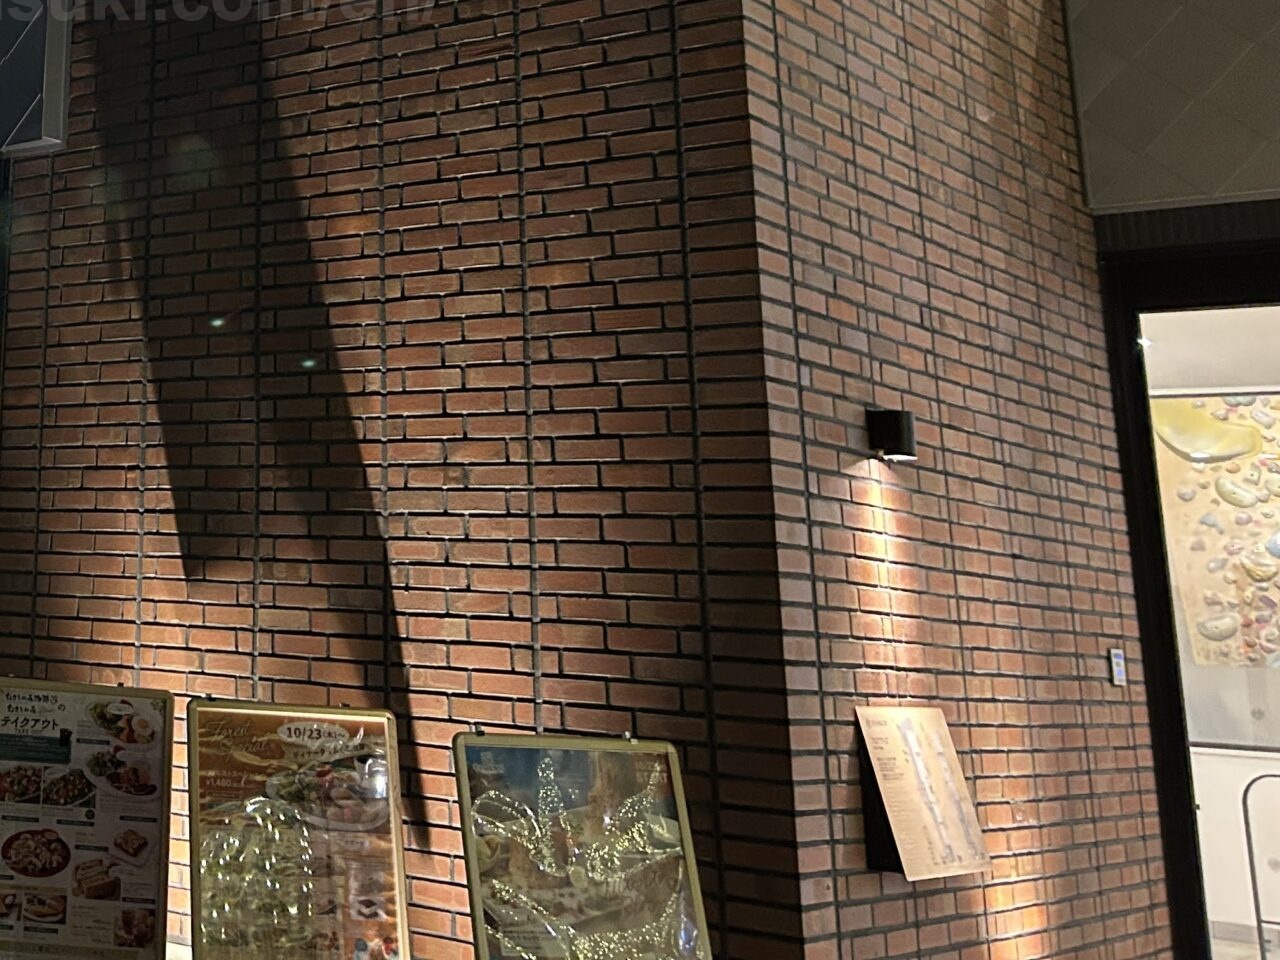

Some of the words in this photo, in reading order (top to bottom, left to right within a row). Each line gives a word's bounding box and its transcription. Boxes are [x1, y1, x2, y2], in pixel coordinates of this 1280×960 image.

[1, 716, 59, 730] テイクアウト
